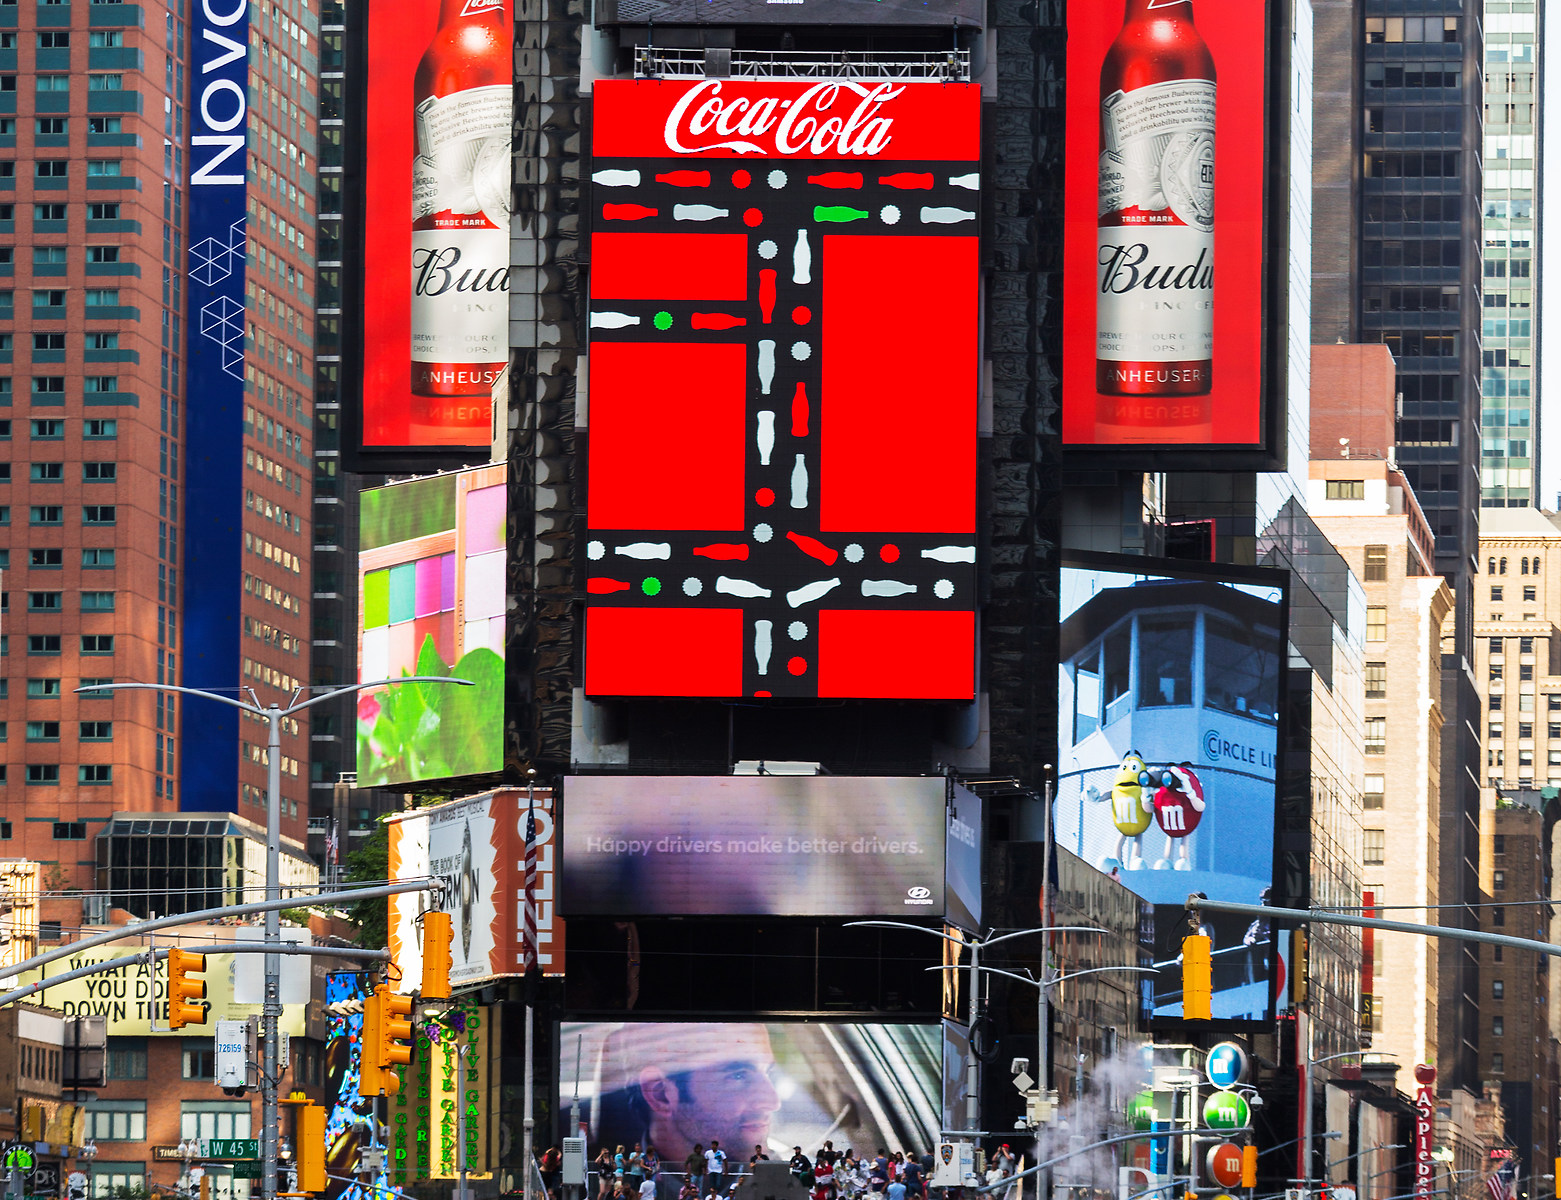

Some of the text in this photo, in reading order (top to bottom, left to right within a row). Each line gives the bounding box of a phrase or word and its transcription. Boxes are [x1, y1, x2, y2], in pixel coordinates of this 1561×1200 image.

[1205, 734, 1256, 764] CIRCLE
[587, 836, 924, 856] Happy drivers make better drivers.
[69, 957, 127, 978] WHAT
[86, 979, 127, 998] YOU
[63, 1000, 127, 1023] DOWN
[218, 1043, 242, 1053] 726159
[440, 1028, 456, 1176] OLIVE GARDEN
[465, 1015, 481, 1169] OLIVE GARDEN
[416, 1036, 431, 1180] OLIVE GARDEN
[212, 1141, 258, 1156] W 45 St
[395, 1112, 408, 1184] GARDEN
